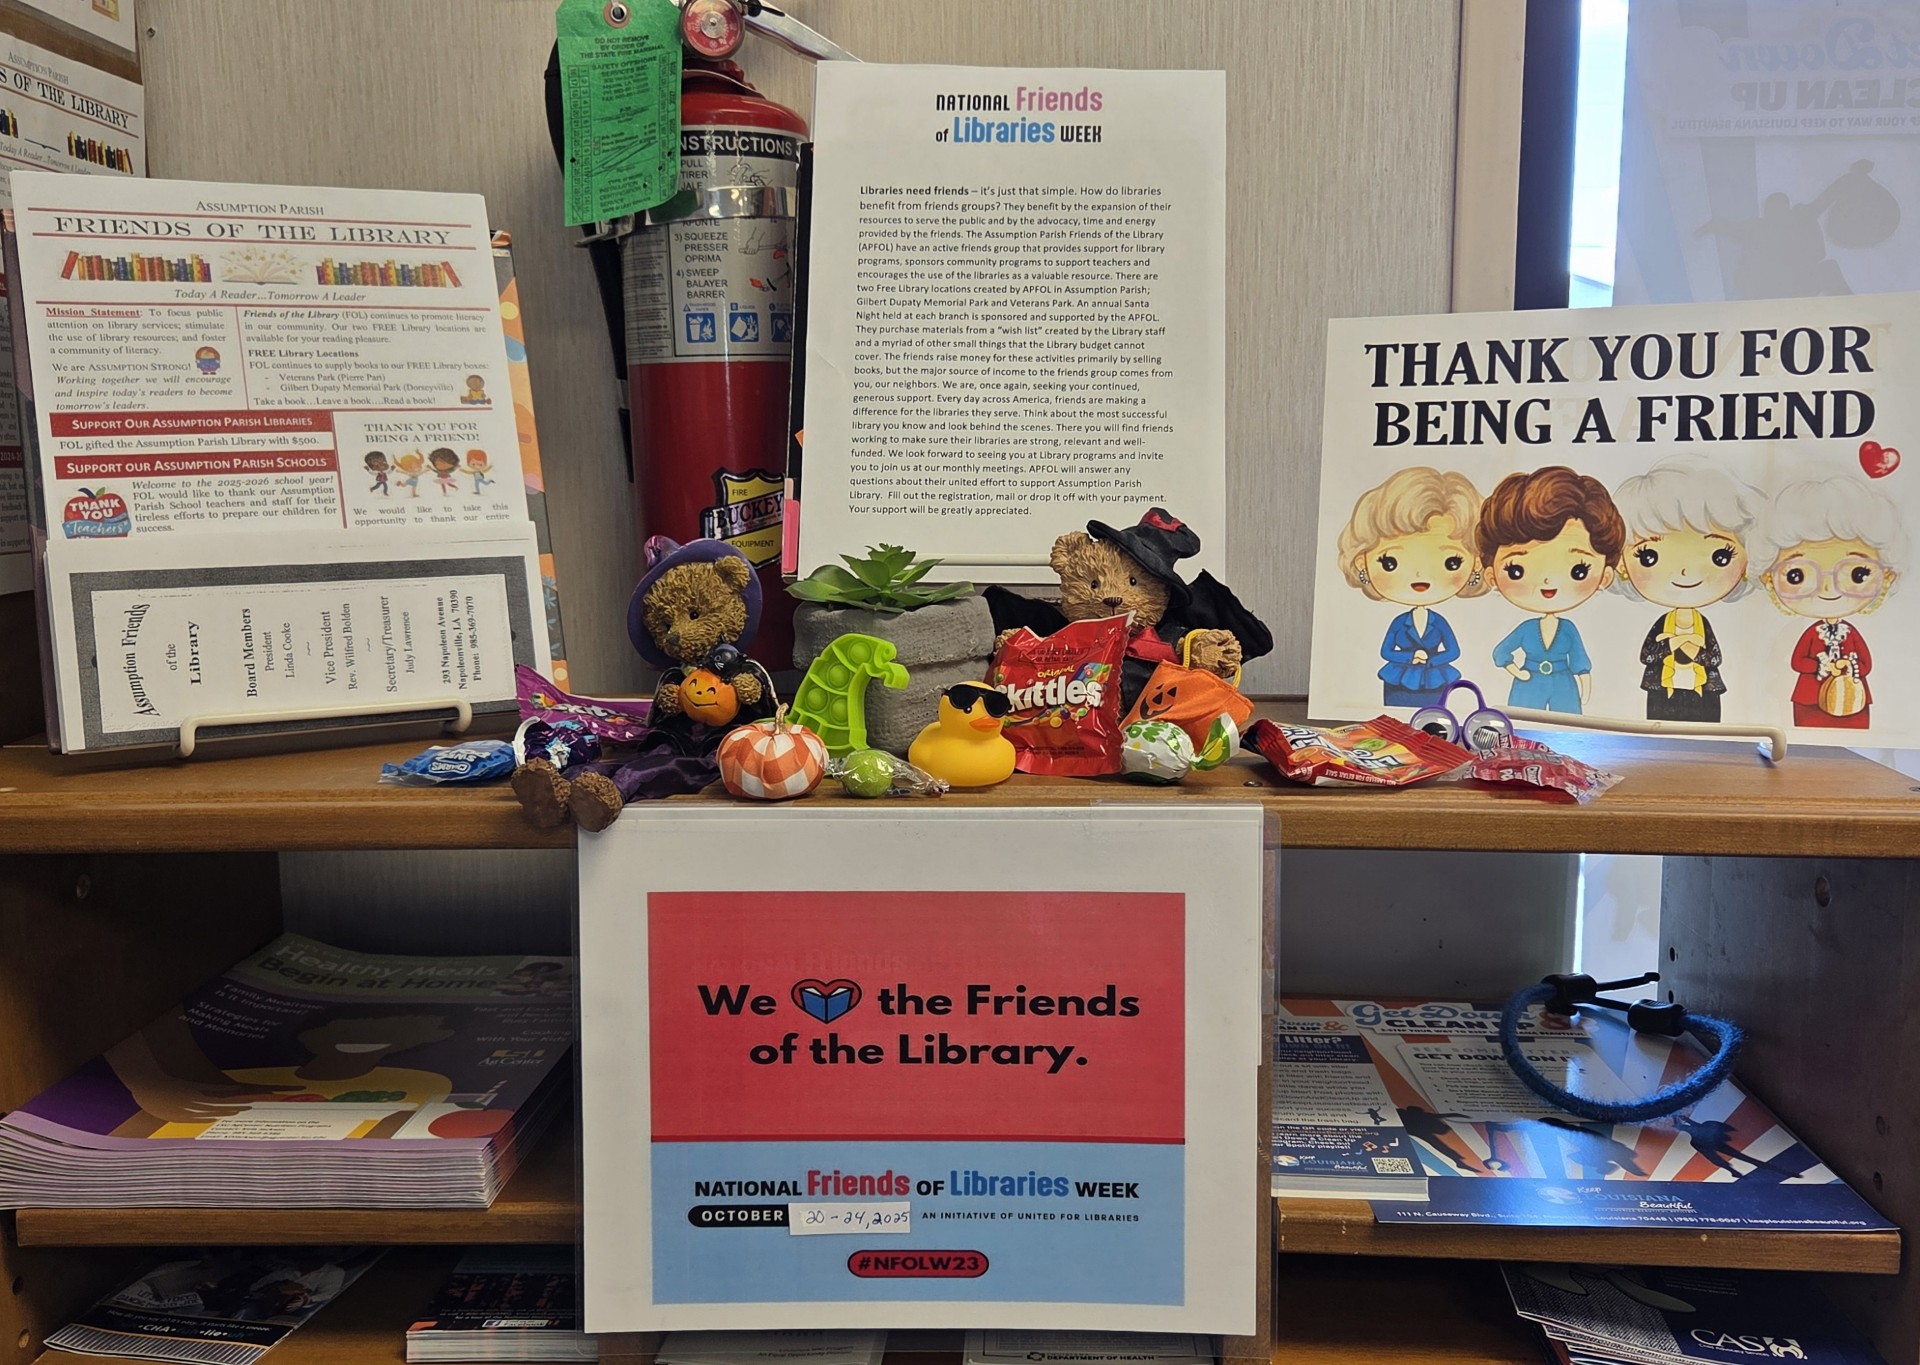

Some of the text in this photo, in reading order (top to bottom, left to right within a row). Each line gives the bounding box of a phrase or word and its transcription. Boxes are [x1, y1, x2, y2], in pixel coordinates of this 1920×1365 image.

[14, 73, 129, 128] OF THE LIBRARY
[936, 87, 1102, 112] NATIONAL Friends
[935, 116, 1102, 143] of Libraries WEEK
[680, 136, 792, 156] NSTRUCTIONS
[681, 160, 703, 168] PULL
[681, 171, 709, 179] TIRER
[196, 200, 325, 216] ASSUMPTION PARISH
[859, 200, 1172, 213] benefit from friends groups? They benefit by the expansion of their
[53, 216, 451, 245] FRIENDS OF THE LIBRARY
[684, 232, 728, 241] SQUEEZE
[685, 243, 729, 252] PRESSER
[685, 255, 722, 263] OPRIMA
[686, 268, 719, 277] SWEEP
[686, 280, 728, 288] BALAYER
[687, 290, 725, 299] BARRER
[1364, 325, 1874, 388] THANK YOU FOR
[71, 416, 313, 430] SUPPORT OUR ASSUMPTION PARISH LIBRARIES
[363, 422, 478, 432] THANK YOU FOR
[1373, 389, 1878, 447] BEING A FRIEND
[59, 435, 320, 452] FOL gifted the Assumption Parish Library with $500.
[365, 433, 480, 444] BEING A FRIEND!
[66, 456, 327, 474] SUPPORT OUR ASSUMPTION PARISH SCHOOLS
[716, 494, 783, 528] BUCKEY
[848, 504, 1032, 517] Your support will be greatly appreciated.
[732, 540, 774, 548] EQUIPMENT
[187, 621, 202, 685] Library
[241, 608, 258, 697] Board Members
[262, 631, 275, 672] President
[280, 622, 296, 679] Linda Cooke
[319, 610, 337, 685] Vice President
[340, 603, 359, 690] Rev. Wilfred Bolden
[379, 595, 398, 693] Secretary/Treasurer
[402, 611, 416, 674] Judy Lawrence
[436, 597, 452, 684] 293 Napoleon Avenue
[450, 590, 469, 690] Napoleonville, LA 70390
[121, 603, 160, 717] Assumption Friends
[165, 643, 178, 671] of the
[258, 956, 498, 990] Begin at Home
[276, 946, 401, 978] Healthy
[407, 966, 497, 977] Meals
[697, 984, 777, 1016] We
[877, 983, 1140, 1017] the Friends
[1386, 1019, 1487, 1029] CLEAN
[749, 1032, 1088, 1074] of the Library.
[694, 1169, 1140, 1199] NATIONAL Friends OF Libraries WEEK
[701, 1209, 783, 1222] OCTOBER
[805, 1209, 826, 1224] 20
[921, 1211, 1139, 1222] AN INITIATIVE OF UNITED FOR LIBRARIES
[857, 1255, 980, 1274] #NFOLW23
